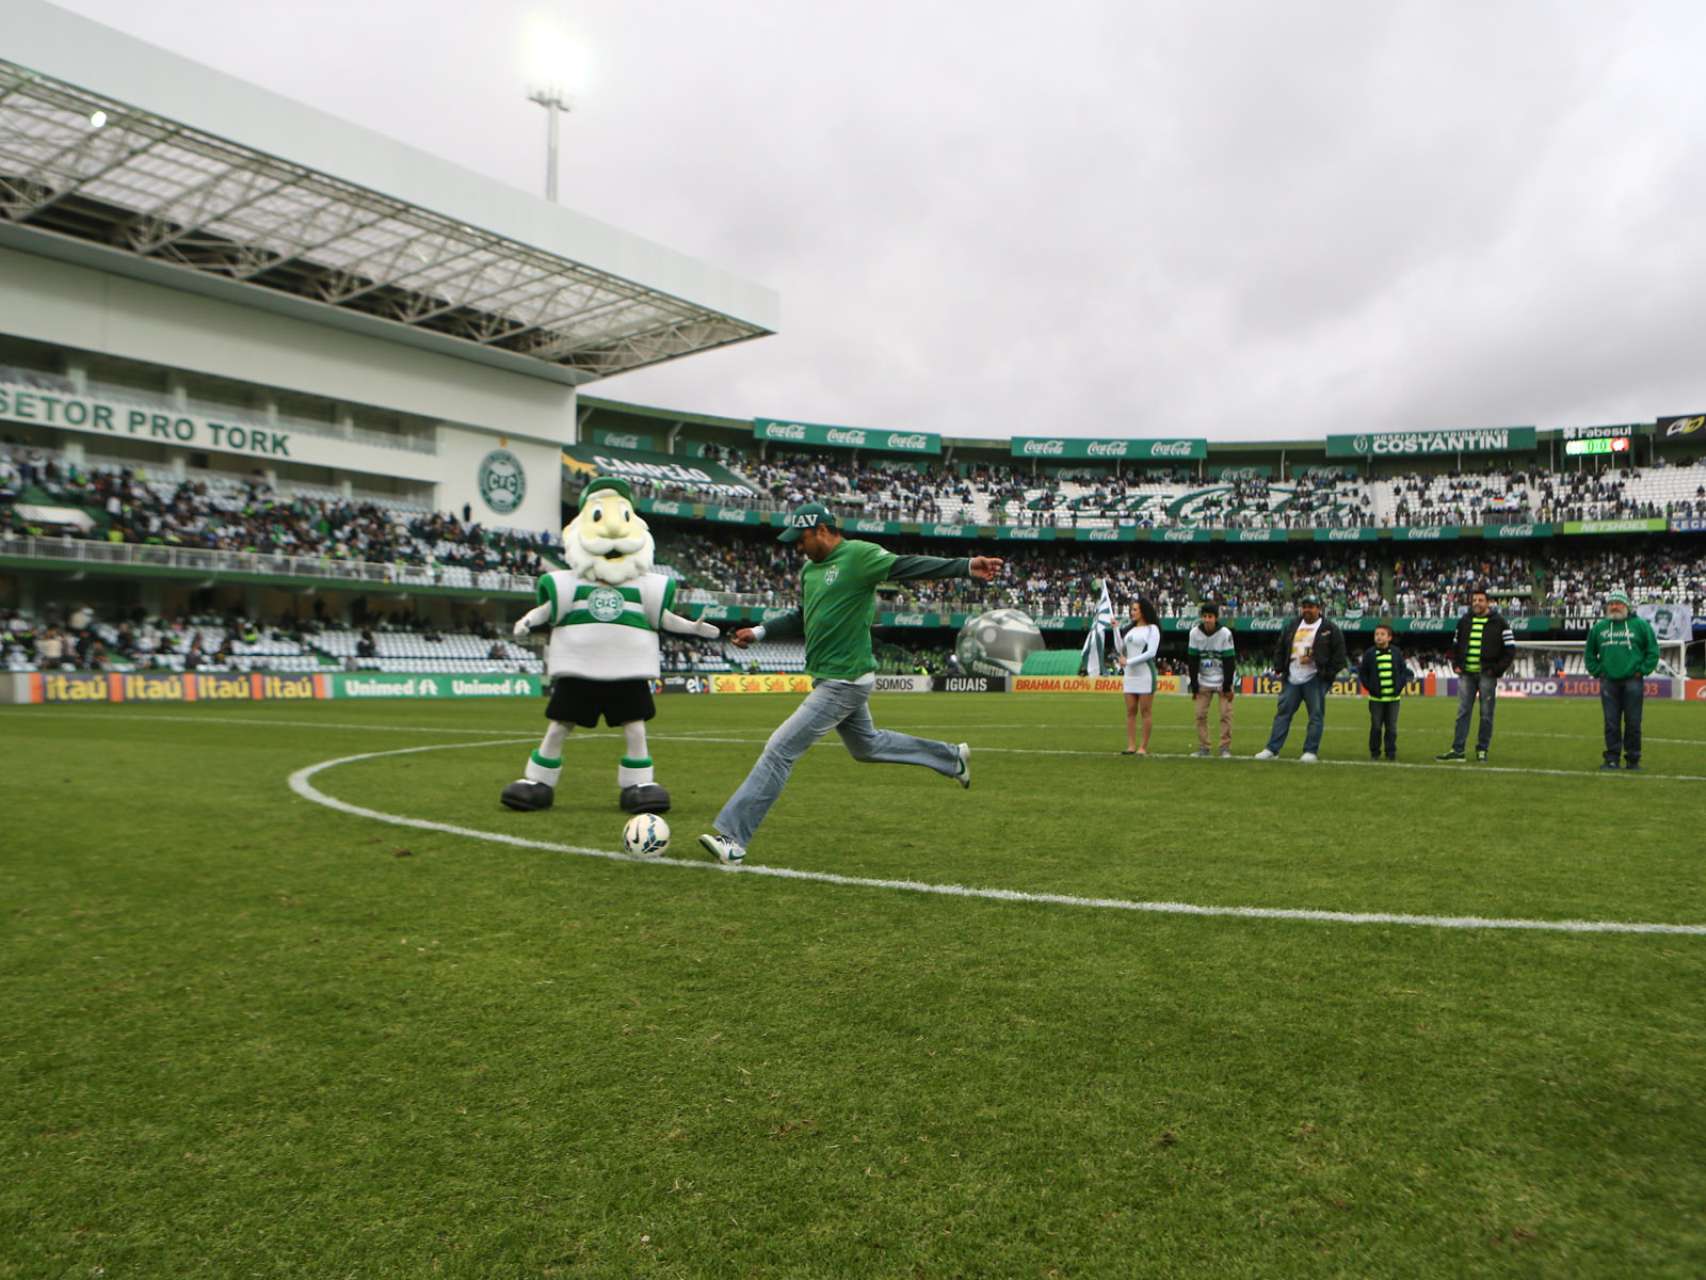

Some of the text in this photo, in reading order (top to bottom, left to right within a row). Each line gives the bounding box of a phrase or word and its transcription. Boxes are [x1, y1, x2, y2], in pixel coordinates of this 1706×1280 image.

[128, 410, 195, 441] PRO
[207, 422, 290, 456] TORK
[766, 422, 806, 440] Coca-Cola
[826, 428, 867, 445] Coca-Cola
[887, 433, 927, 449] Coca-Cola
[1023, 440, 1064, 454] Coca-Cola
[1087, 441, 1128, 455] Coca-Cola
[1151, 441, 1192, 455] Coca-Cola
[1372, 434, 1508, 453] COSTANTINI
[46, 674, 107, 699] Itaú
[126, 674, 182, 698] Itaú
[198, 675, 249, 698] Itaú
[264, 675, 312, 698] Itaú
[345, 679, 415, 696] Unimed
[452, 679, 513, 695] Unimed
[875, 678, 913, 690] SOMOS
[945, 678, 987, 691] IGUAIS
[1016, 680, 1060, 690] BRAHMA
[1095, 680, 1124, 690] BRAH
[1256, 677, 1282, 693] Ita
[1331, 679, 1356, 695] aú
[1509, 682, 1558, 694] TUDO
[1564, 680, 1600, 694] LIGU
